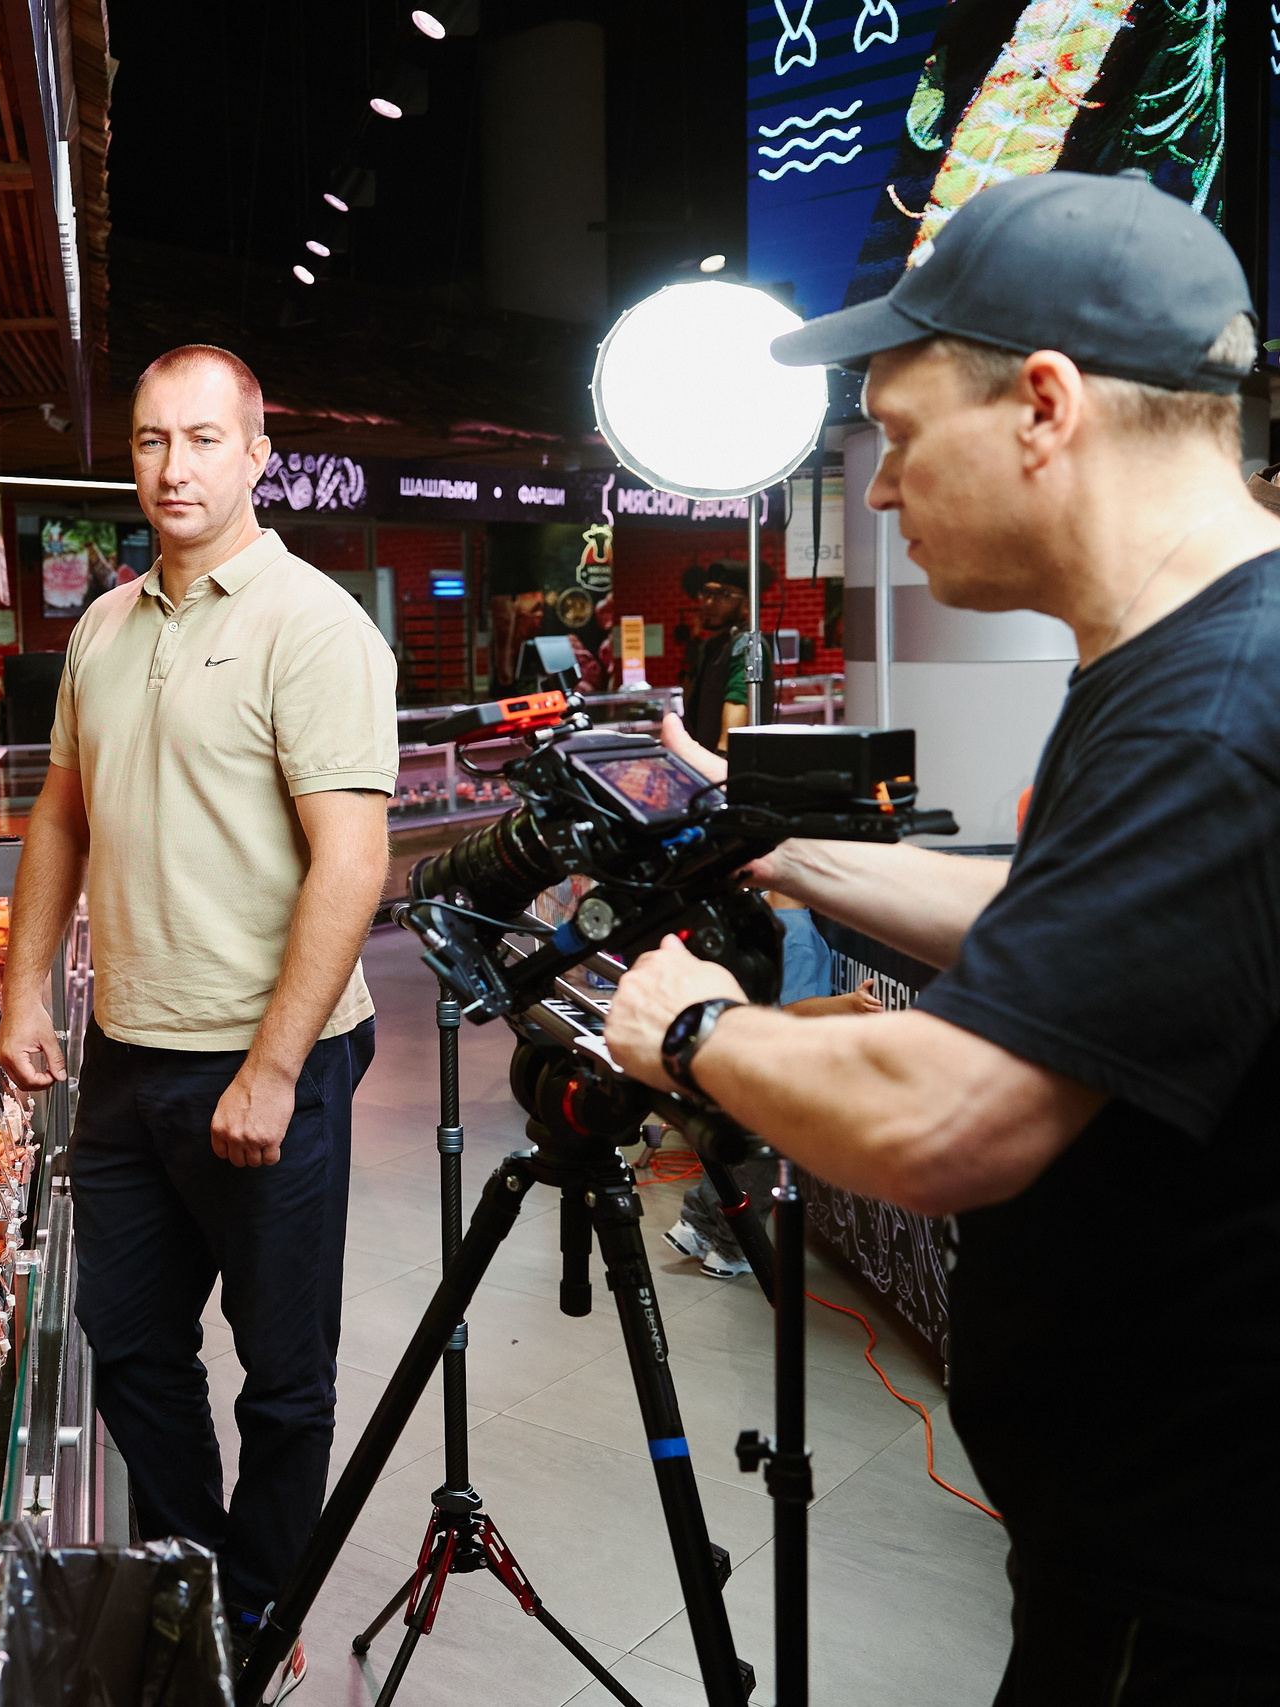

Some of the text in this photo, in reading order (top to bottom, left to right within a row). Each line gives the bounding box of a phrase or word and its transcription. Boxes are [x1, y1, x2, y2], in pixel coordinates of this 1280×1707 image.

[400, 477, 565, 506] ШАШЛЫКИ ФАРШИ
[644, 1307, 665, 1363] BENRO
